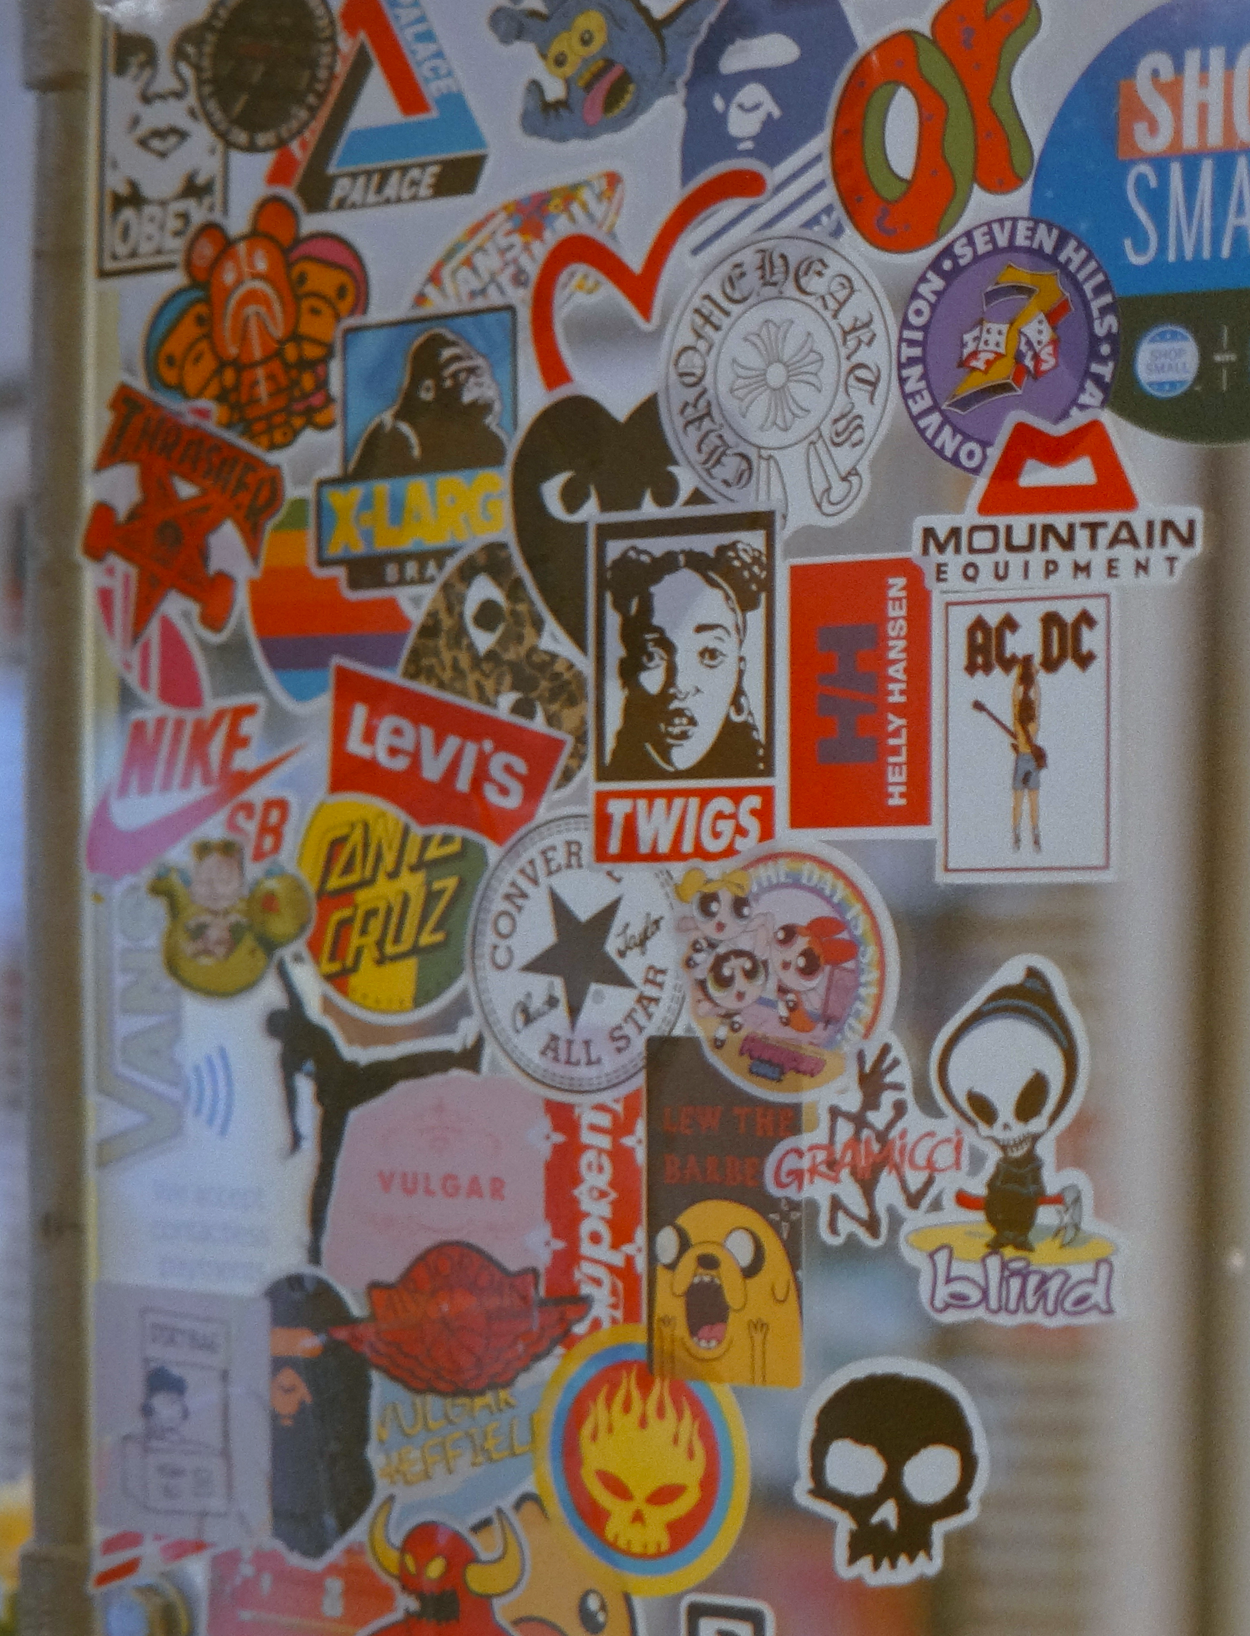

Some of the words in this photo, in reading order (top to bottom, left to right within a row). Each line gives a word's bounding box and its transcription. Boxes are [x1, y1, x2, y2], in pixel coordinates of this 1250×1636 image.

[387, 0, 463, 99] ALACE
[327, 164, 443, 211] PALACE
[953, 219, 1060, 267] SEVEN
[1057, 237, 1119, 337] HILLS
[900, 270, 996, 470] ONVENTION
[107, 396, 279, 542] THRASHER
[326, 471, 504, 556] X-LARG
[921, 519, 1197, 556] MOUNTAIN
[384, 557, 446, 585] BRA
[934, 556, 1180, 583] EQUIPMENT
[886, 576, 907, 692] HANSEN
[117, 702, 260, 798] NIKE
[886, 697, 906, 806] HELLY
[226, 797, 289, 863] SB
[605, 795, 762, 855] TWIGS
[319, 875, 461, 981] CRUZ
[490, 840, 622, 971] CONVER
[538, 1032, 601, 1067] ALL
[607, 963, 669, 1056] STAR
[662, 1104, 723, 1136] LEW
[731, 1105, 796, 1138] THE
[377, 1170, 507, 1202] VULGAR
[663, 1152, 762, 1188] BARBE
[573, 1098, 625, 1335] Suprem
[928, 1245, 1116, 1317] blind
[379, 1417, 534, 1486] HEFFIEL
